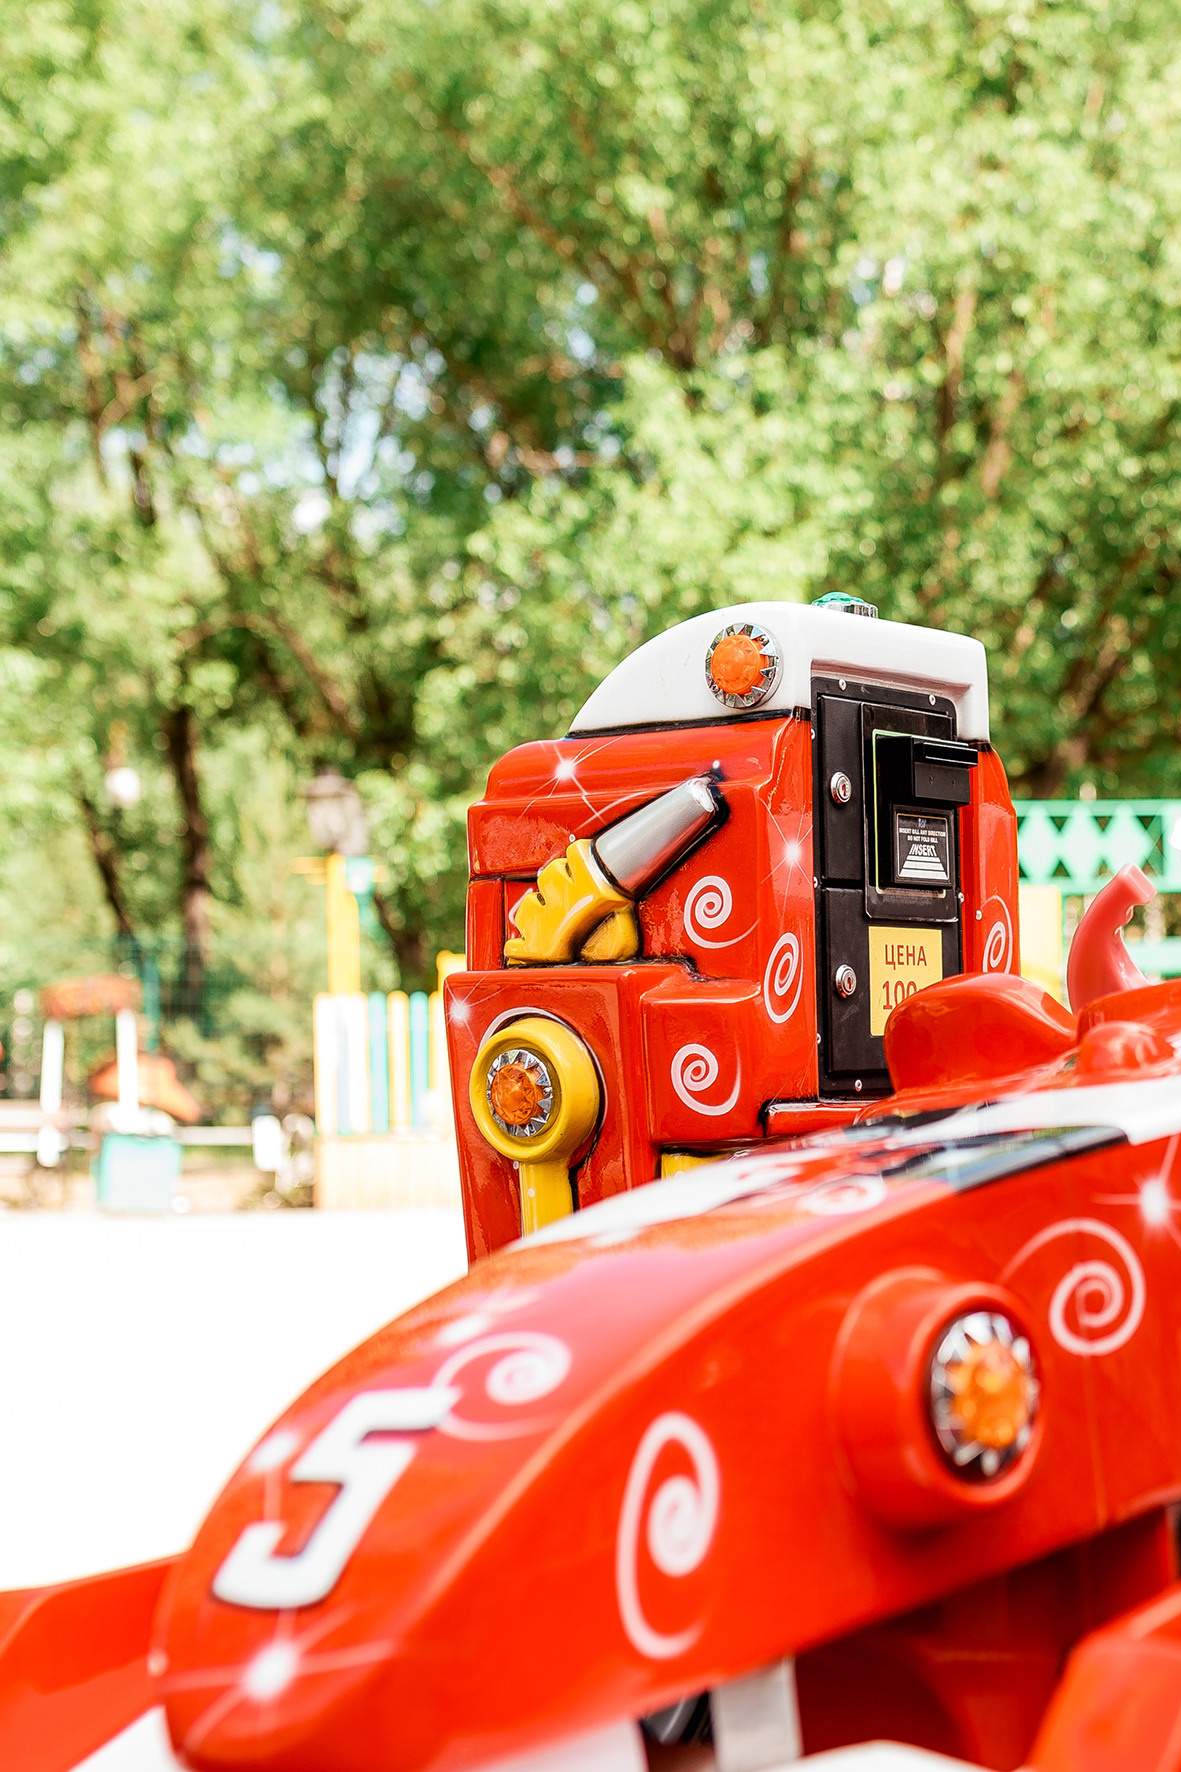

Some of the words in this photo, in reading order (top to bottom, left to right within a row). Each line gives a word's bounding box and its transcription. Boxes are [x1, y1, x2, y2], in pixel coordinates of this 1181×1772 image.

[909, 843, 937, 857] INSERT
[885, 944, 927, 970] ЦЕНА
[210, 1385, 464, 1612] 5
